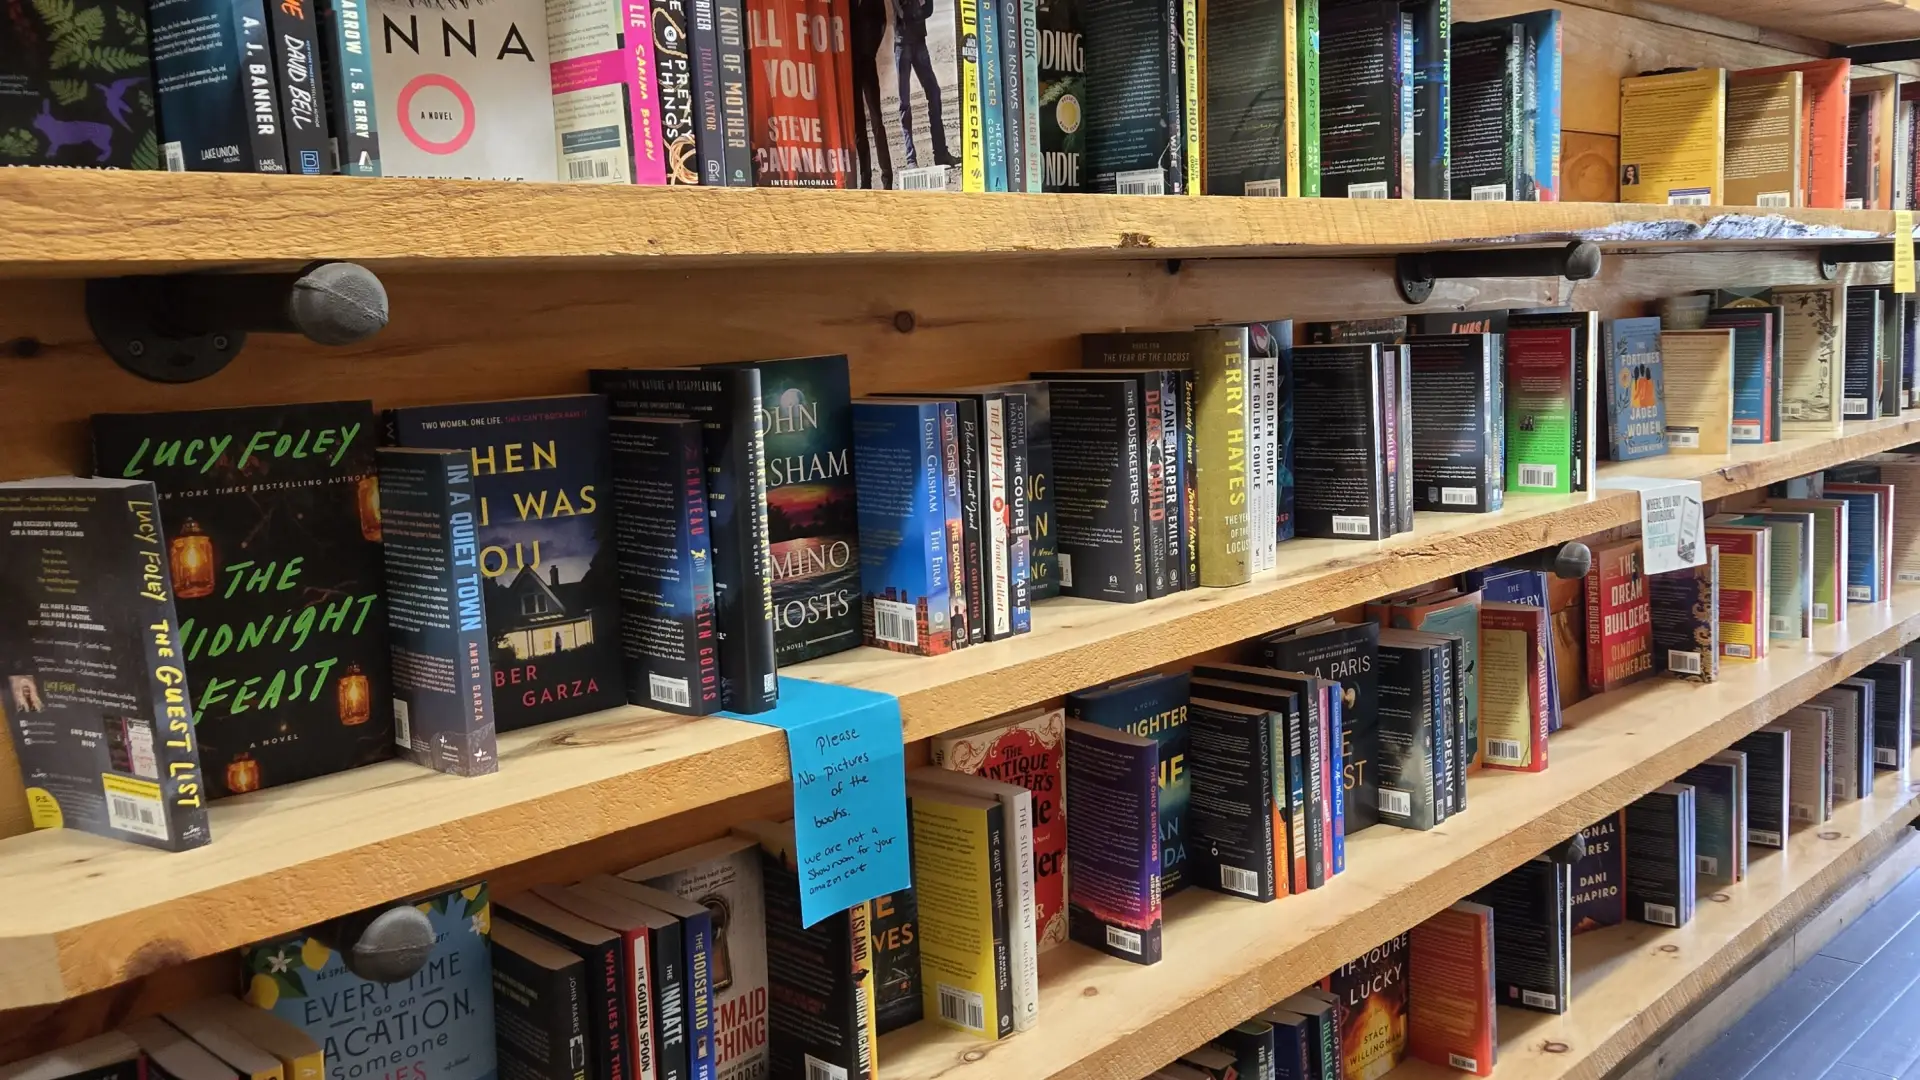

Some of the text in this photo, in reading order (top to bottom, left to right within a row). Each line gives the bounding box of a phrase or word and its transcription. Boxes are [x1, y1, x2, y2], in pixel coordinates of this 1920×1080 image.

[628, 4, 648, 99] LIE SARINA
[796, 12, 845, 52] FOR
[1307, 16, 1316, 72] BLOCK
[249, 62, 275, 135] BANNER
[660, 59, 678, 138] THINGS
[675, 59, 692, 140] PRETTY
[762, 59, 817, 101] YOU
[983, 13, 1003, 167] THAN WATER MEGAN COLLINS
[1008, 55, 1019, 110] KNOWS
[1185, 11, 1198, 143] COUPLE PHOTO
[429, 112, 453, 121] NOVEL
[724, 82, 746, 148] MOTHER
[968, 92, 980, 162] SECRET
[1308, 79, 1316, 131] PARTY
[768, 115, 821, 142] STEVE
[757, 147, 851, 173] CAVANAGH
[771, 179, 838, 187] INTERNATIONALLY
[1117, 352, 1190, 362] YEAR LOCUST
[1621, 351, 1660, 366] FORTUNES
[642, 380, 722, 392] NATURE DISAPPEARING
[422, 416, 503, 430] TWO WOMEN. ONE LIFE.
[1009, 402, 1017, 449] HANNAH
[1628, 422, 1660, 437] WOMEN
[1630, 406, 1658, 420] JADED
[123, 422, 361, 477] LUCY FOLEY
[991, 406, 1002, 493] THE APPEAL
[1127, 407, 1139, 505] HOUSEKEEPERS
[1253, 394, 1262, 490] GOLDEN COUPLE
[1266, 391, 1275, 487] GOLDEN COUPLE
[180, 479, 323, 498] YORK TIMES BESTSELLING
[1163, 400, 1179, 556] JANE HARPER EXILES
[1184, 379, 1197, 566] Everybody Jordan Harper
[1228, 429, 1245, 506] HAYES
[513, 485, 596, 522] WAS
[924, 418, 943, 587] JOHN GRISHAM THE FIRM
[944, 409, 962, 597] John Grisham THE EXCHANGE
[1014, 476, 1024, 534] COUPLE
[1404, 473, 1412, 511] JEWELL
[1133, 525, 1141, 552] ALEX
[224, 557, 304, 599] THE
[1134, 554, 1143, 575] HAY
[1619, 552, 1636, 577] THE
[447, 464, 483, 721] IN QUIET TOWN AMBER GARZA
[1016, 570, 1026, 614] TABLE
[1588, 575, 1600, 645] DREAM BUILDERS
[1611, 580, 1643, 607] DREAM
[1604, 603, 1650, 636] BUILDERS
[128, 500, 200, 808] LUCY FOLEY THE GUEST LIST
[700, 648, 716, 700] GOLDIS
[1330, 655, 1371, 678] PARIS
[1607, 653, 1652, 683] MUKHERJEE
[192, 657, 338, 725] FEAST
[522, 679, 599, 707] GARZA
[1538, 660, 1548, 741] MURDER BOOK
[1289, 711, 1301, 757] FALLING
[1433, 666, 1443, 764] LOUISE PENNY
[1441, 648, 1454, 792] LOUISE PENNY
[263, 734, 299, 746] NOVEL
[815, 728, 860, 755] Please
[1308, 701, 1321, 804] THE RESEMBLANCE
[799, 772, 816, 790] No
[831, 774, 869, 796] of the
[814, 807, 850, 828] books.
[804, 827, 878, 865] we are not a
[857, 845, 870, 855] for
[875, 836, 897, 853] your
[809, 863, 867, 895] amazon cart
[1019, 806, 1032, 931] THE SILENT PATIENT
[1579, 872, 1607, 887] DANI
[1570, 886, 1618, 906] SHAPIRO
[304, 982, 391, 1026] EVERY
[569, 976, 580, 1034] JOHN MARRS
[604, 950, 621, 1051] WHAT LIES IN
[693, 951, 708, 1031] HOUSEMAID
[1350, 963, 1403, 1007] LUCKY
[637, 966, 650, 1073] THE GOLDEN SPOON
[1363, 1025, 1390, 1045] STACY
[1322, 1021, 1334, 1070] DELICATE
[1349, 1032, 1402, 1066] WILLINGHAM
